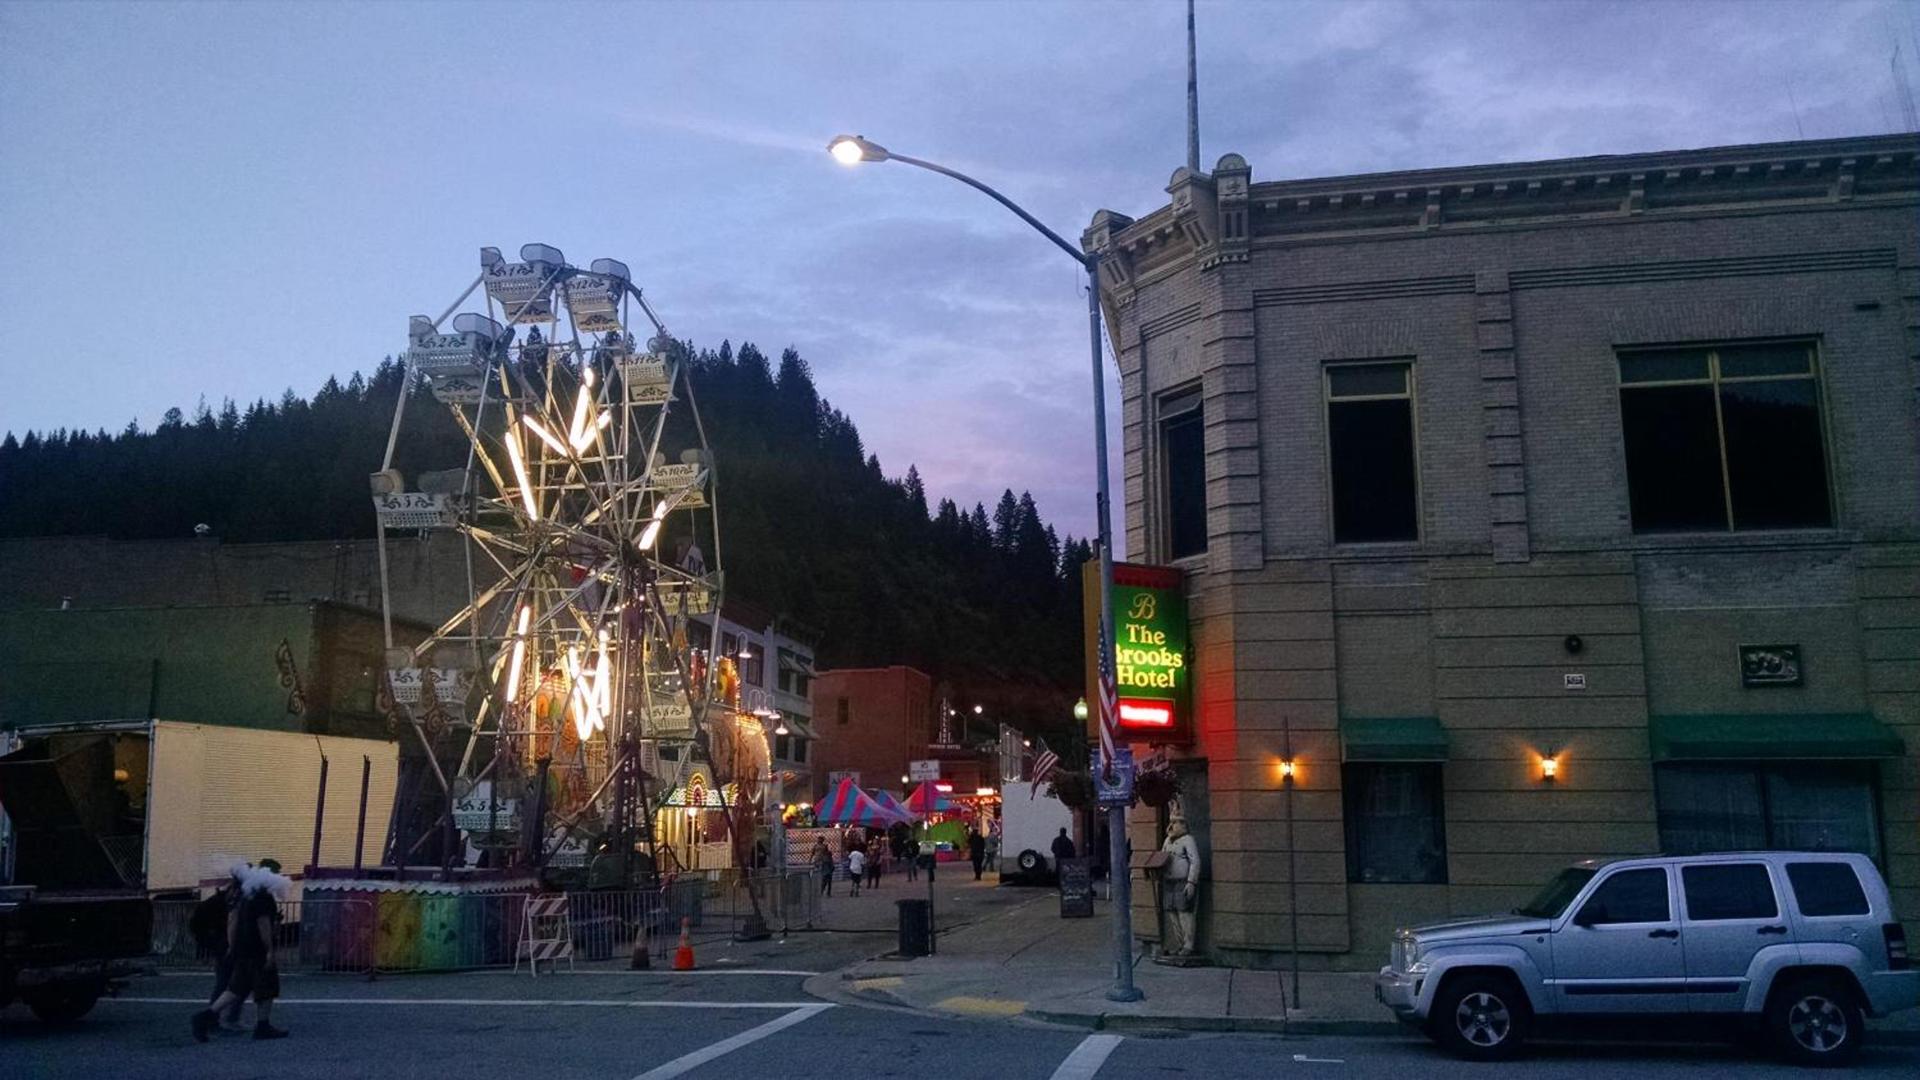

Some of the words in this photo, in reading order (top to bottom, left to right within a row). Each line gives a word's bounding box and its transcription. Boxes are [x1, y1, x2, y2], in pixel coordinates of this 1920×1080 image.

[438, 337, 447, 348] 2
[1128, 592, 1156, 619] B
[1126, 623, 1166, 645] The
[1116, 664, 1176, 689] Hotel
